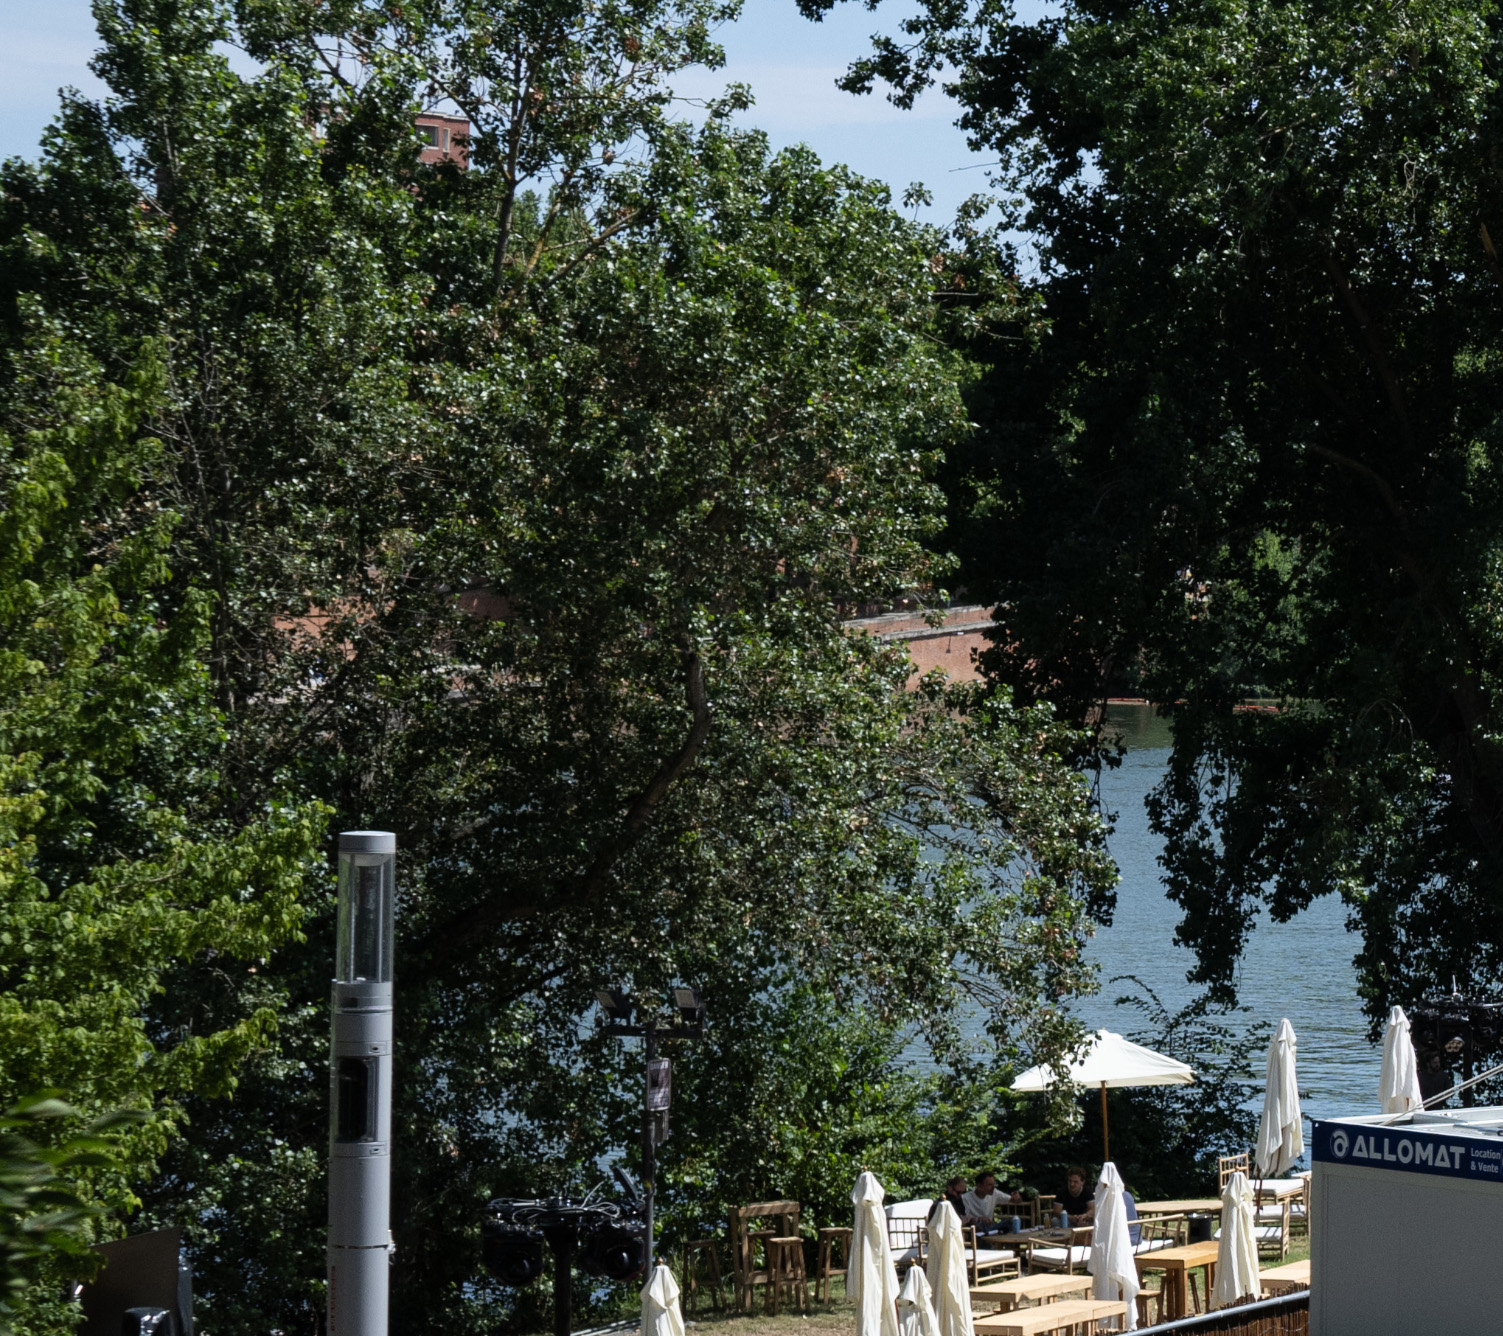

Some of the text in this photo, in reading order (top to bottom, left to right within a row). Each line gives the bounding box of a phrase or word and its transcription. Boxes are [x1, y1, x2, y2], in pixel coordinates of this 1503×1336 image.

[1352, 1134, 1466, 1170] ALLOMAT
[1470, 1147, 1501, 1160] Location
[1470, 1160, 1477, 1171] &
[1477, 1161, 1499, 1173] Vente
